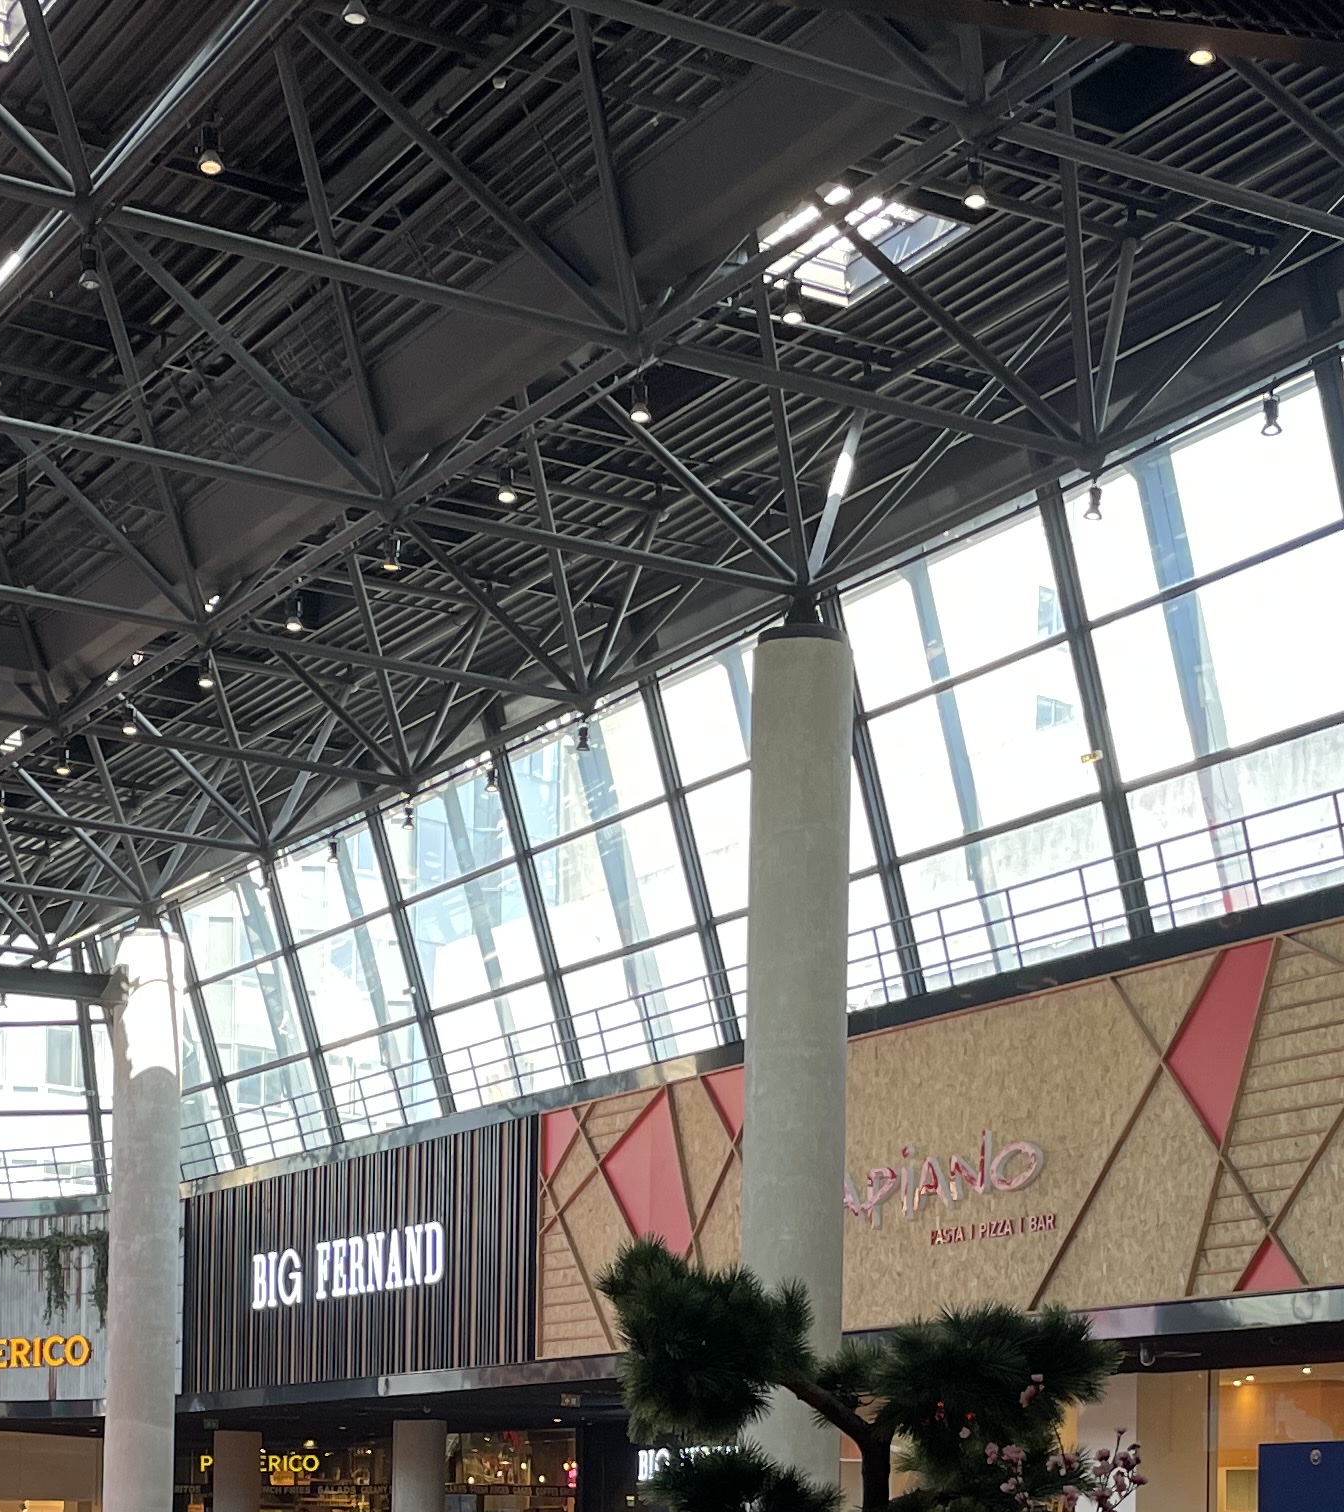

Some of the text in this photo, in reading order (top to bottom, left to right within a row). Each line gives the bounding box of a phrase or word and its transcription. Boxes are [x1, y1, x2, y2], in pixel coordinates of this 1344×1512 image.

[843, 1130, 1044, 1230] PIANO
[930, 1212, 1057, 1246] PASTA PIZZA BAR
[252, 1220, 444, 1310] BIG FERNAND
[317, 1485, 356, 1494] SALADS
